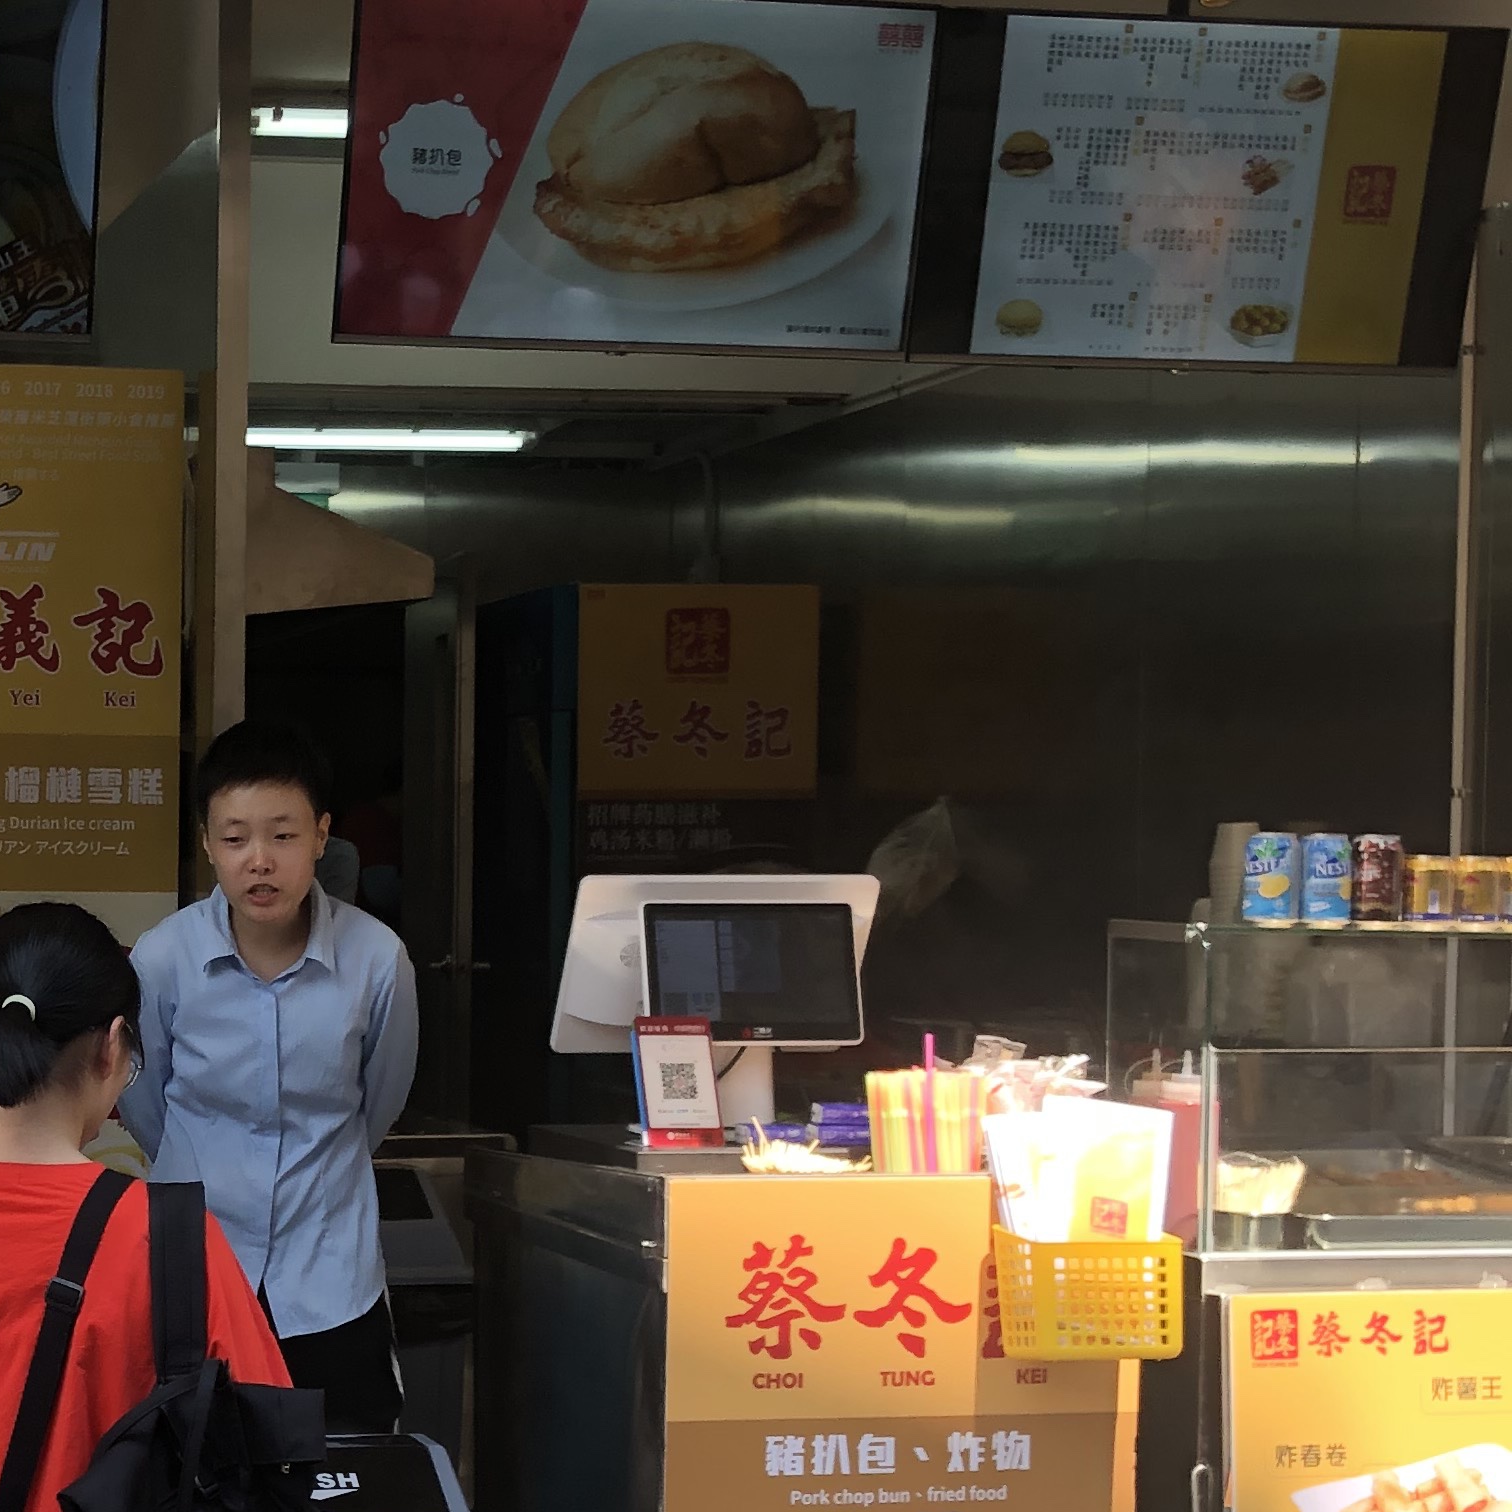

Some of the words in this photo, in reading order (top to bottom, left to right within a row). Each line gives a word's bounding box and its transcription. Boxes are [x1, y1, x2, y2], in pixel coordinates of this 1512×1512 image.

[24, 381, 61, 397] 2017
[75, 383, 113, 398] 2018
[127, 384, 165, 400] 2019
[9, 689, 41, 706] Yei
[103, 690, 136, 707] Kei
[602, 699, 792, 761] 蔡冬記
[9, 816, 60, 831] Durian
[63, 816, 85, 831] Ice
[88, 818, 136, 832] cream
[724, 1234, 1005, 1361] 蔡冬
[1307, 1309, 1450, 1358] 蔡冬記
[752, 1371, 804, 1389] CHOI
[880, 1369, 936, 1388] TUNG
[1016, 1367, 1048, 1385] KEI
[1431, 1375, 1503, 1401] 炸薯王
[764, 1429, 1032, 1478] 豬扒包、炸物
[1274, 1443, 1348, 1469] 炸春卷
[790, 1490, 830, 1506] Pork
[833, 1489, 874, 1507] chop
[878, 1488, 911, 1504] bun
[927, 1485, 967, 1502] fried
[969, 1484, 1008, 1502] food
